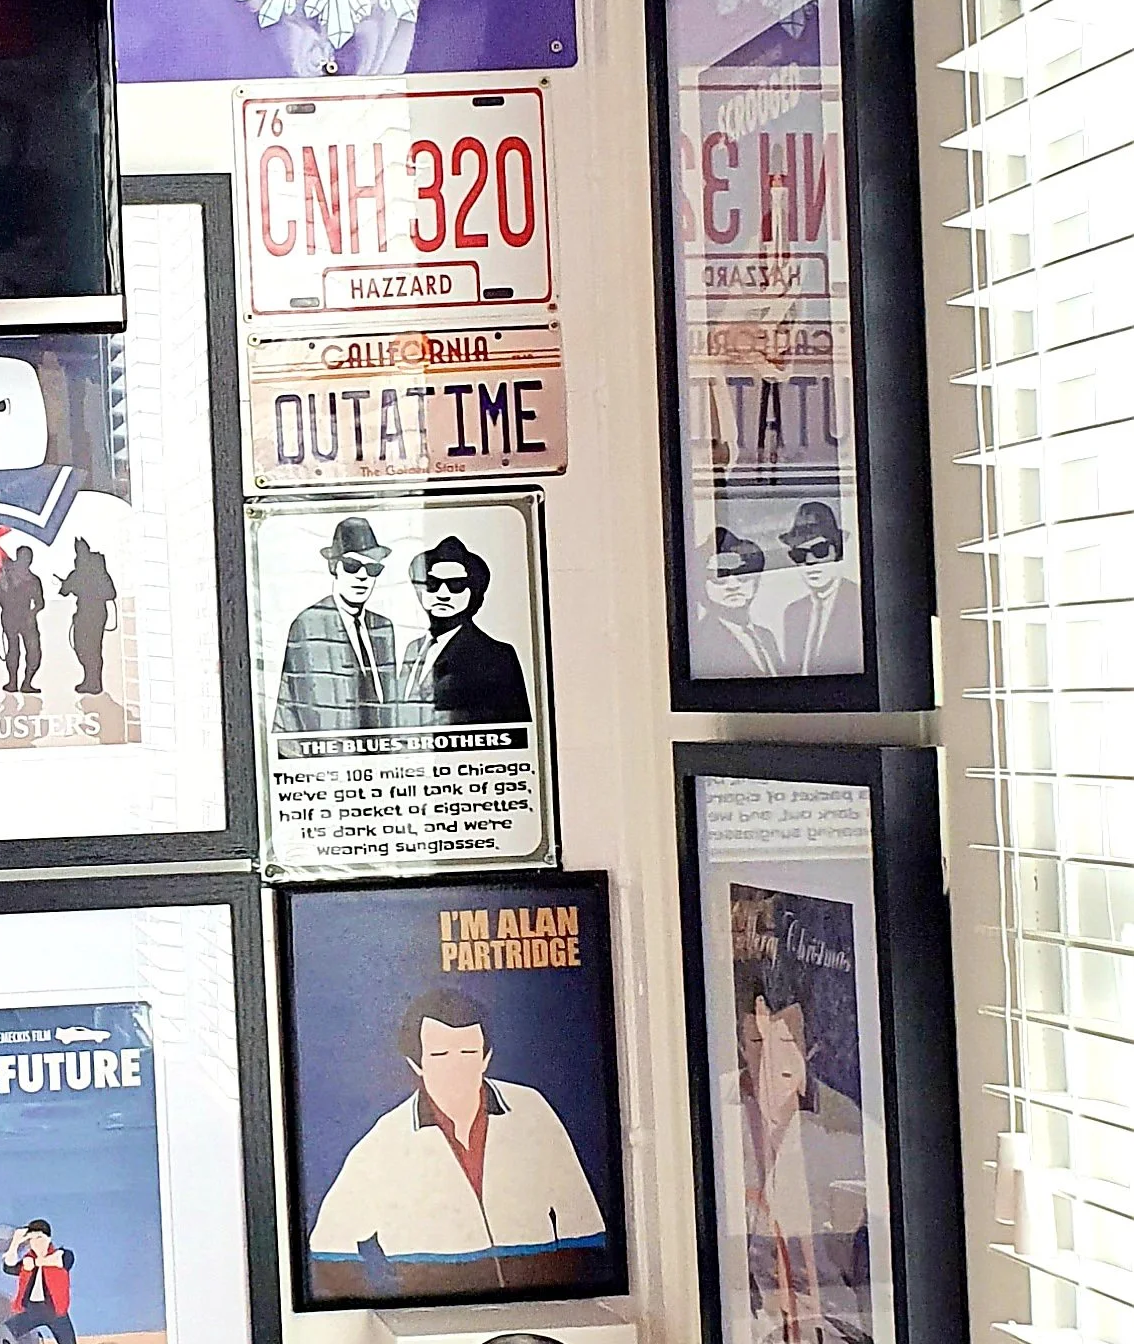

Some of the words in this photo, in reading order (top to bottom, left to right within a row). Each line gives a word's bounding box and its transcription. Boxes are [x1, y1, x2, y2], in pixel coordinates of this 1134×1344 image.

[255, 109, 283, 137] 76
[259, 142, 388, 257] CNH
[407, 136, 536, 253] 320
[350, 274, 453, 300] HAZZARD
[321, 336, 489, 370] CALIFORNIA
[275, 380, 546, 465] OUTATIME
[301, 740, 338, 755] THE
[341, 737, 403, 753] BLUES
[407, 733, 512, 751] BROTHERS
[273, 770, 339, 785] There's
[346, 768, 373, 782] 106
[380, 766, 425, 780] miles
[433, 765, 451, 777] to
[278, 788, 327, 802] we've
[334, 787, 366, 803] got
[371, 788, 382, 798] a
[390, 785, 416, 798] full
[424, 783, 463, 796] tank
[469, 781, 487, 795] of
[279, 807, 315, 822] half
[321, 809, 332, 819] a
[339, 804, 403, 820] packet
[408, 802, 427, 816] of
[301, 826, 326, 839] it's
[333, 824, 377, 838] dark
[424, 820, 458, 833] and
[464, 817, 513, 831] we're
[316, 841, 389, 857] wearing
[440, 909, 488, 942] I'M
[497, 905, 580, 939] ALAN
[441, 937, 581, 973] PARTRIDGE
[32, 1030, 51, 1043] FILM
